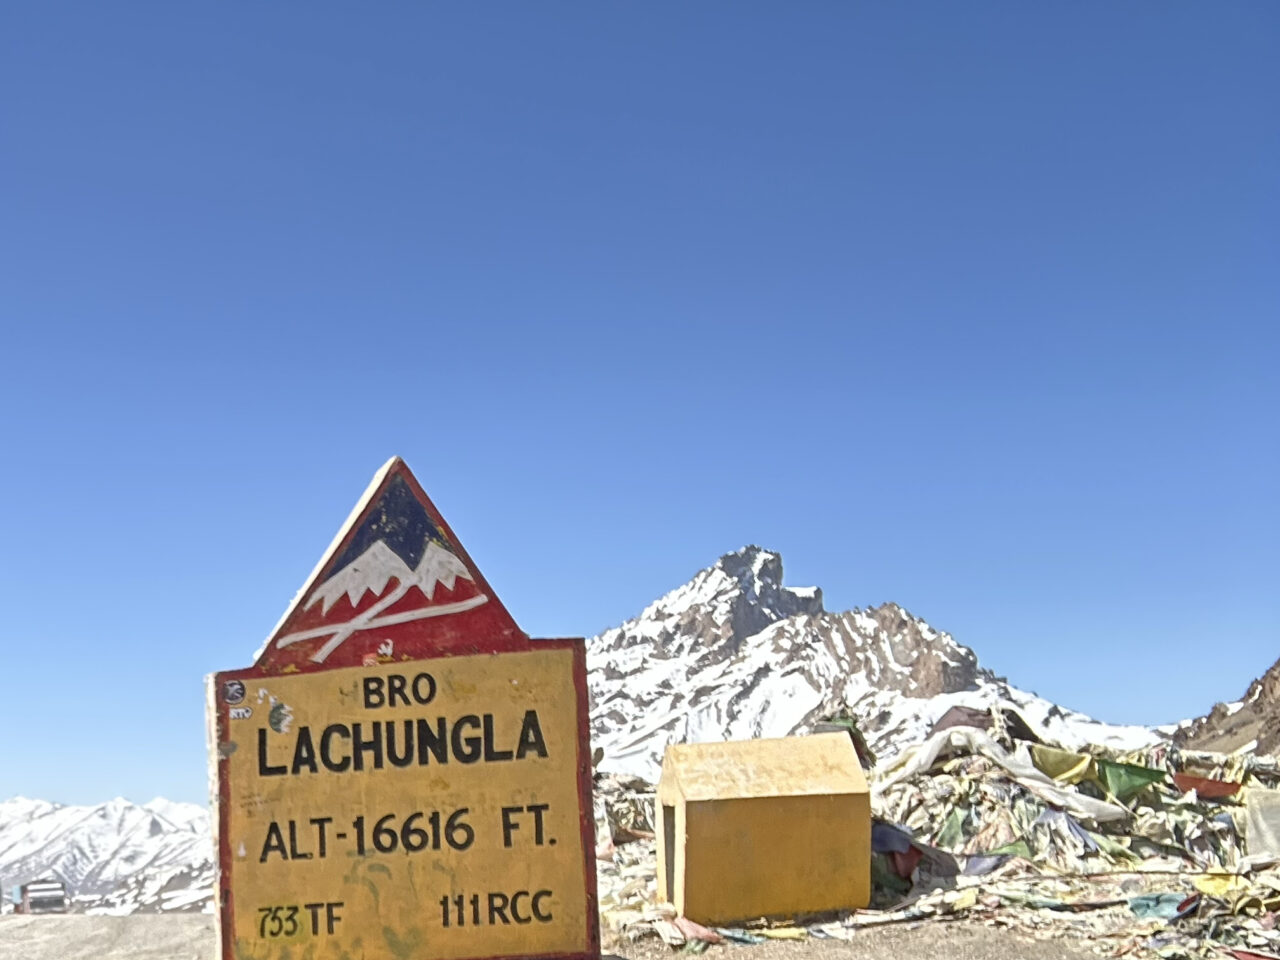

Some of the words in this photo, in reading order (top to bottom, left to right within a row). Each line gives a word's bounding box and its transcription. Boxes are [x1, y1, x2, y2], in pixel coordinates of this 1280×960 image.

[363, 672, 437, 709] BRO
[257, 709, 549, 777] LACHUNGLA
[258, 807, 476, 864] ALT-16616
[501, 803, 558, 849] FT.
